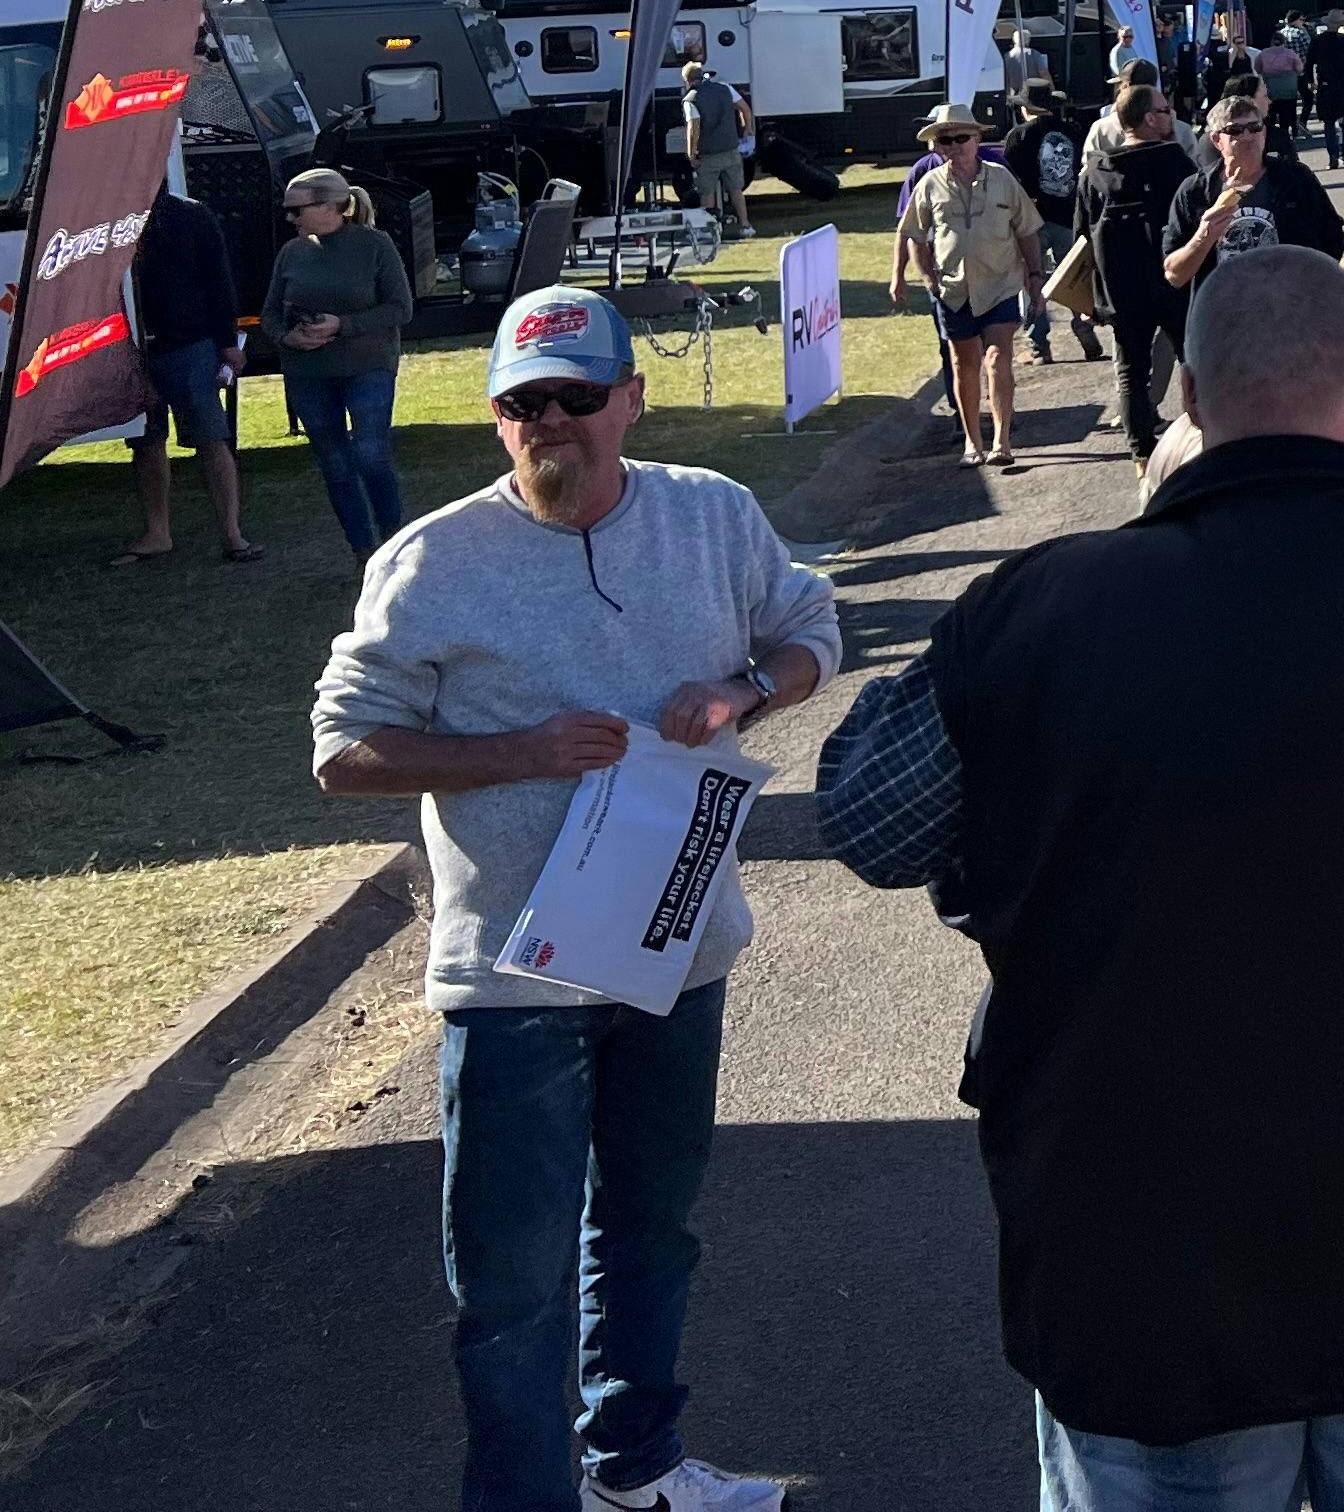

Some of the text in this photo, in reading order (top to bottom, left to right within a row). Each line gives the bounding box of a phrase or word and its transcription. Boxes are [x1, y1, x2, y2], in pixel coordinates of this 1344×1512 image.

[792, 301, 812, 354] RV
[720, 784, 743, 829] Wear
[650, 776, 719, 943] Don't risk your life.
[714, 831, 725, 843] a
[521, 938, 542, 966] NSW
